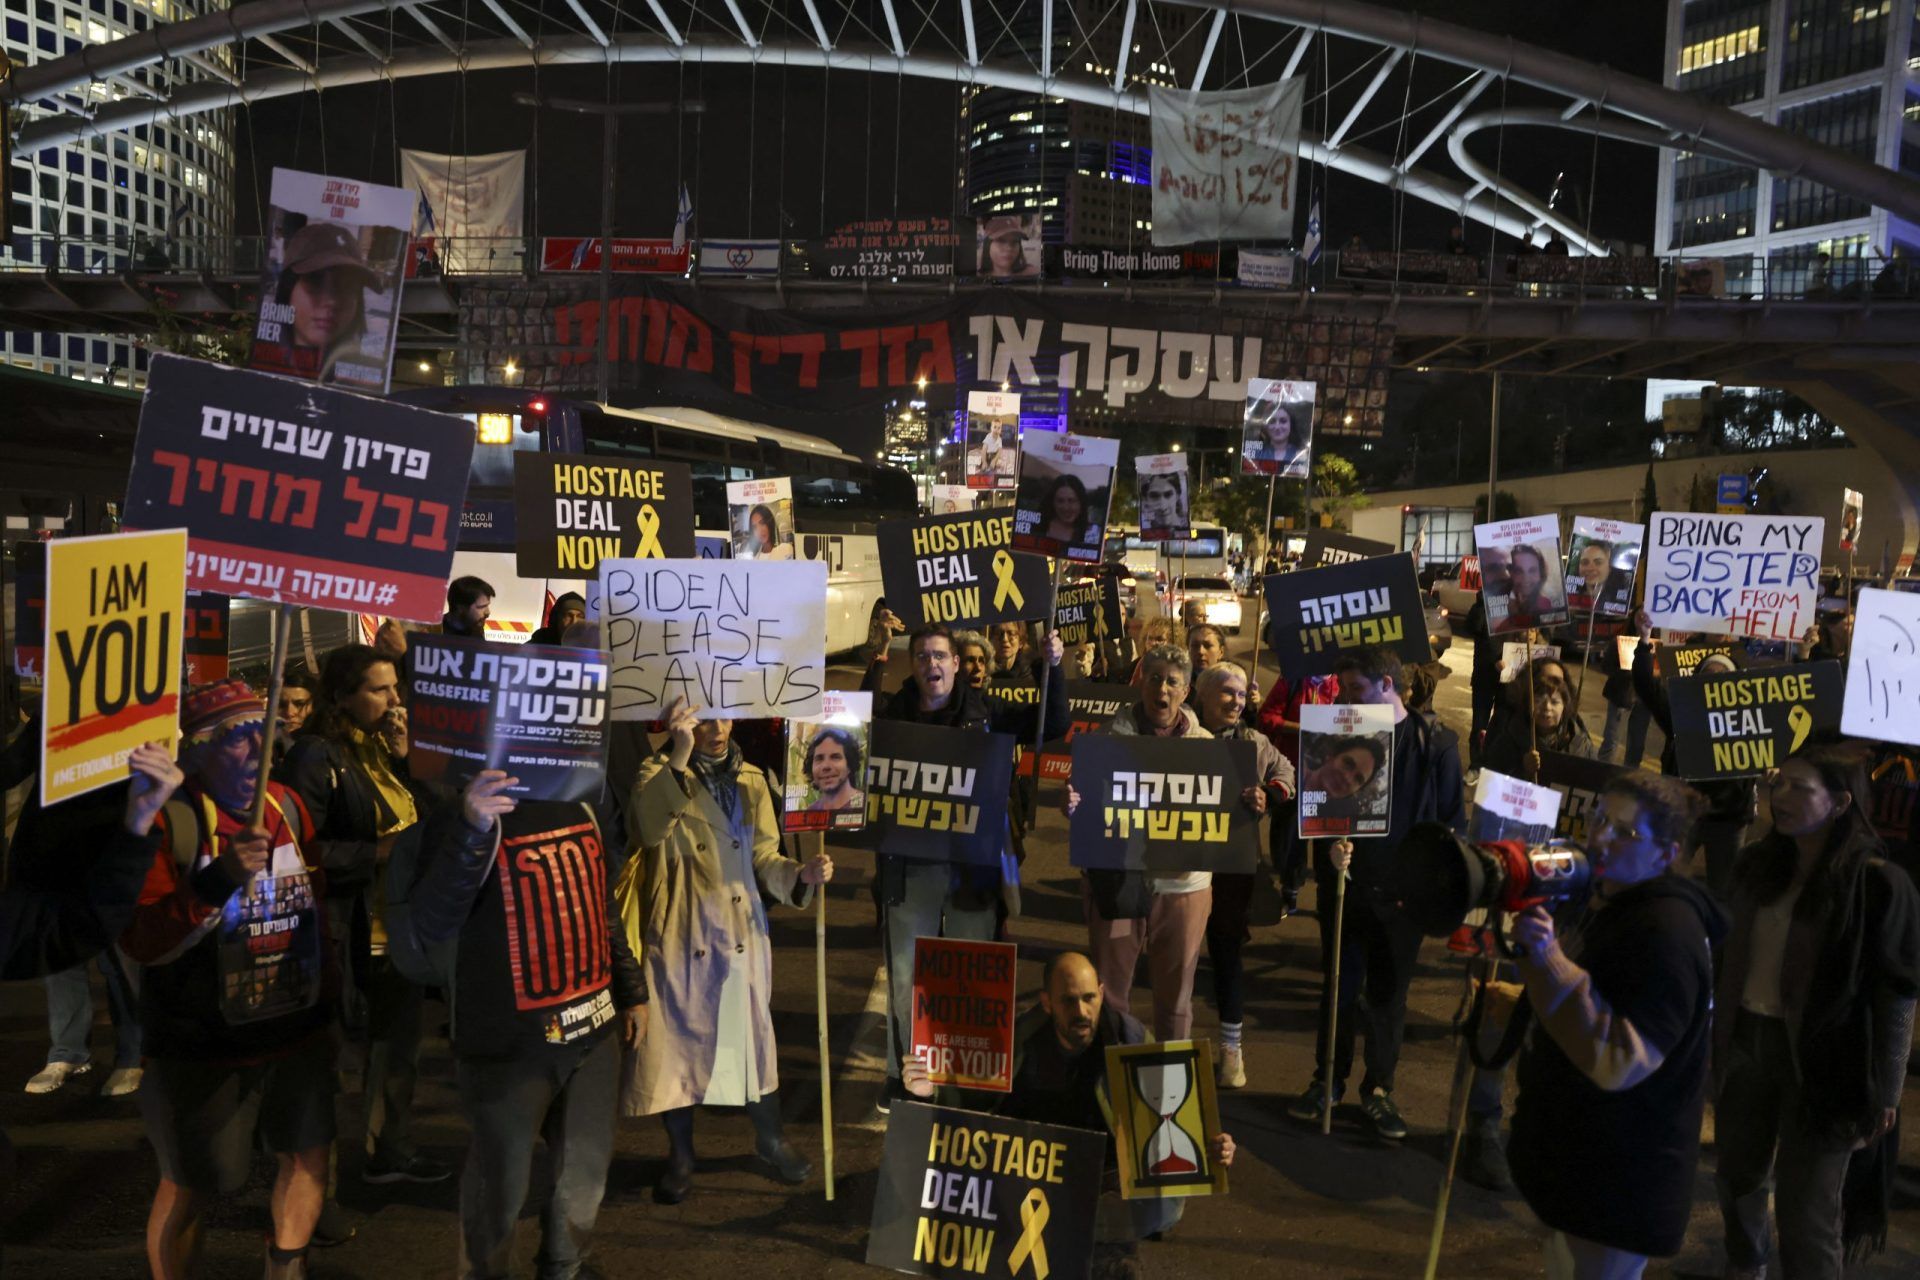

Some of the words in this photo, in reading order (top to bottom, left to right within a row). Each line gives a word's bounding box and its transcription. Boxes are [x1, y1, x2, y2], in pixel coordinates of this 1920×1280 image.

[858, 249, 892, 263] אלבג
[897, 248, 925, 262] לירי
[912, 263, 954, 276] חטופה
[1063, 249, 1098, 273] Bring
[1102, 251, 1138, 271] Them
[1142, 252, 1181, 270] Home
[260, 301, 295, 323] BRING
[257, 321, 281, 342] HER
[729, 329, 826, 394] דין
[839, 320, 956, 388] גזר
[969, 315, 1044, 386] או
[1058, 322, 1262, 407] עסקה
[200, 405, 333, 460] שבויים
[342, 434, 431, 480] פדיון
[153, 449, 322, 529] מחיר
[554, 463, 666, 500] HOSTAGE
[342, 476, 449, 551] בכל
[555, 498, 621, 532] DEAL
[1015, 521, 1032, 534] HER
[1016, 509, 1042, 524] BRING
[912, 516, 1014, 556] HOSTAGE
[1658, 517, 1743, 548] BRING
[1760, 524, 1812, 551] MY
[556, 535, 621, 570] NOW
[90, 567, 97, 617] I
[102, 561, 147, 615] AM
[291, 569, 399, 606] #עסקה
[916, 554, 978, 588] DEAL
[607, 569, 750, 616] BIDEN
[921, 586, 980, 623] NOW
[1299, 586, 1392, 626] עסקה
[1651, 584, 1733, 617] BACK
[1740, 589, 1800, 611] FROM
[1058, 606, 1087, 625] DEAL
[1059, 622, 1088, 643] NOW
[1724, 608, 1804, 643] HELL
[607, 611, 784, 665] PLEASE
[1299, 615, 1404, 654] עכשיו!
[55, 611, 170, 725] YOU
[414, 645, 464, 679] אש
[470, 652, 608, 692] הפסקת
[414, 680, 490, 703] CEASEFIRE
[612, 658, 754, 710] SAVE
[762, 665, 821, 706] US
[1704, 673, 1815, 709] HOSTAGE
[414, 704, 486, 736] NOW!
[496, 690, 605, 726] עכשיו
[1708, 708, 1773, 738] DEAL
[1712, 739, 1775, 772] NOW
[786, 784, 808, 797] BRING
[867, 756, 976, 797] עסקה
[1112, 771, 1223, 809] עסקה
[1302, 791, 1327, 804] BRING
[1302, 804, 1318, 817] HER
[1104, 806, 1230, 843] עכשיו!
[919, 944, 1009, 983] MOTHER
[917, 993, 1008, 1028] MOTHER
[934, 1033, 947, 1046] WE
[949, 1035, 966, 1047] ARE
[967, 1037, 990, 1049] HERE
[915, 1044, 954, 1075] FOR
[959, 1046, 1008, 1081] YOU!
[927, 1122, 1067, 1183] HOSTAGE
[920, 1168, 998, 1221] DEAL
[913, 1217, 995, 1275] NOW
